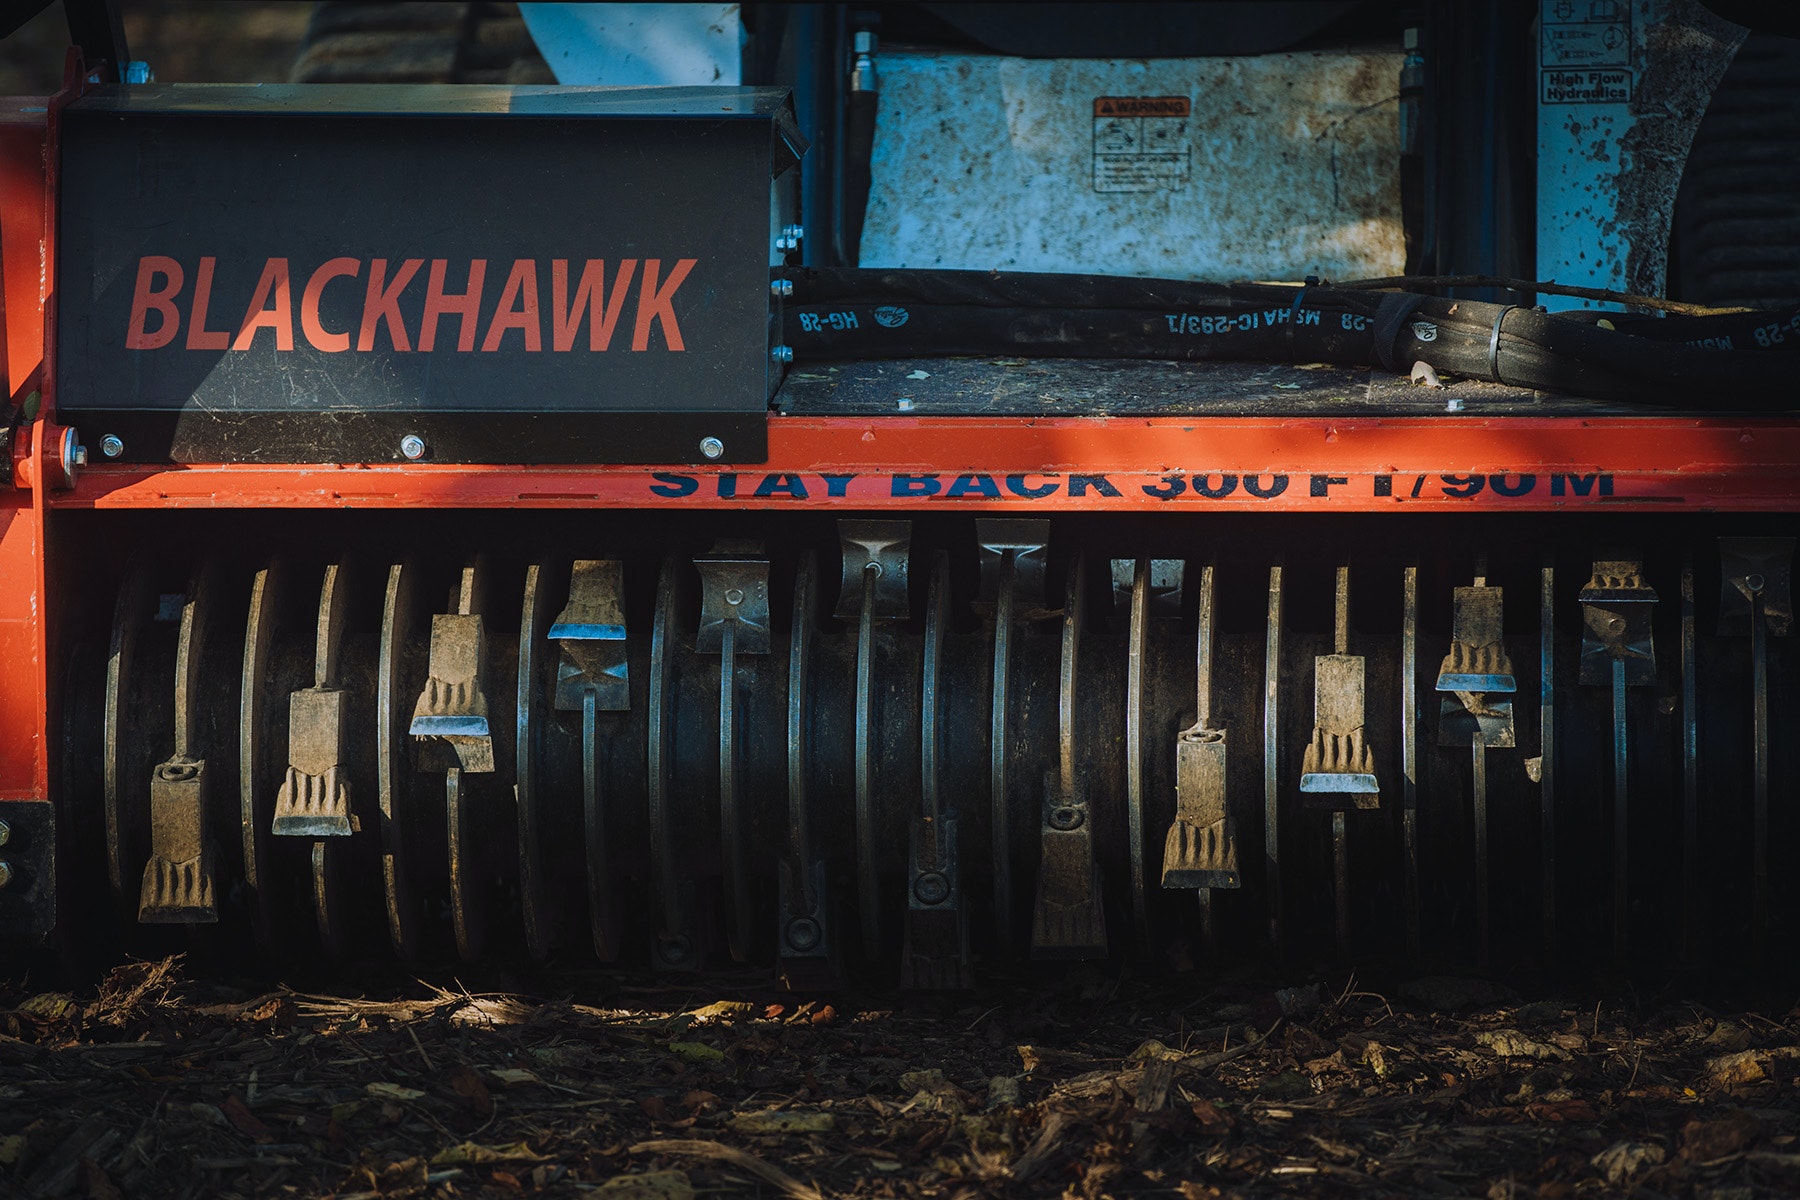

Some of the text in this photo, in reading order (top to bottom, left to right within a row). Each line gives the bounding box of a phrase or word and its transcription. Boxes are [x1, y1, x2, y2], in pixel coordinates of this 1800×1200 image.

[1549, 73, 1625, 87] High Flow
[1547, 87, 1627, 100] Hydraulics
[1117, 101, 1185, 113] WARNING
[125, 255, 698, 352] BLACKHAWK
[799, 311, 859, 332] HG-28
[890, 473, 1123, 499] BACK
[1142, 473, 1289, 499] 300
